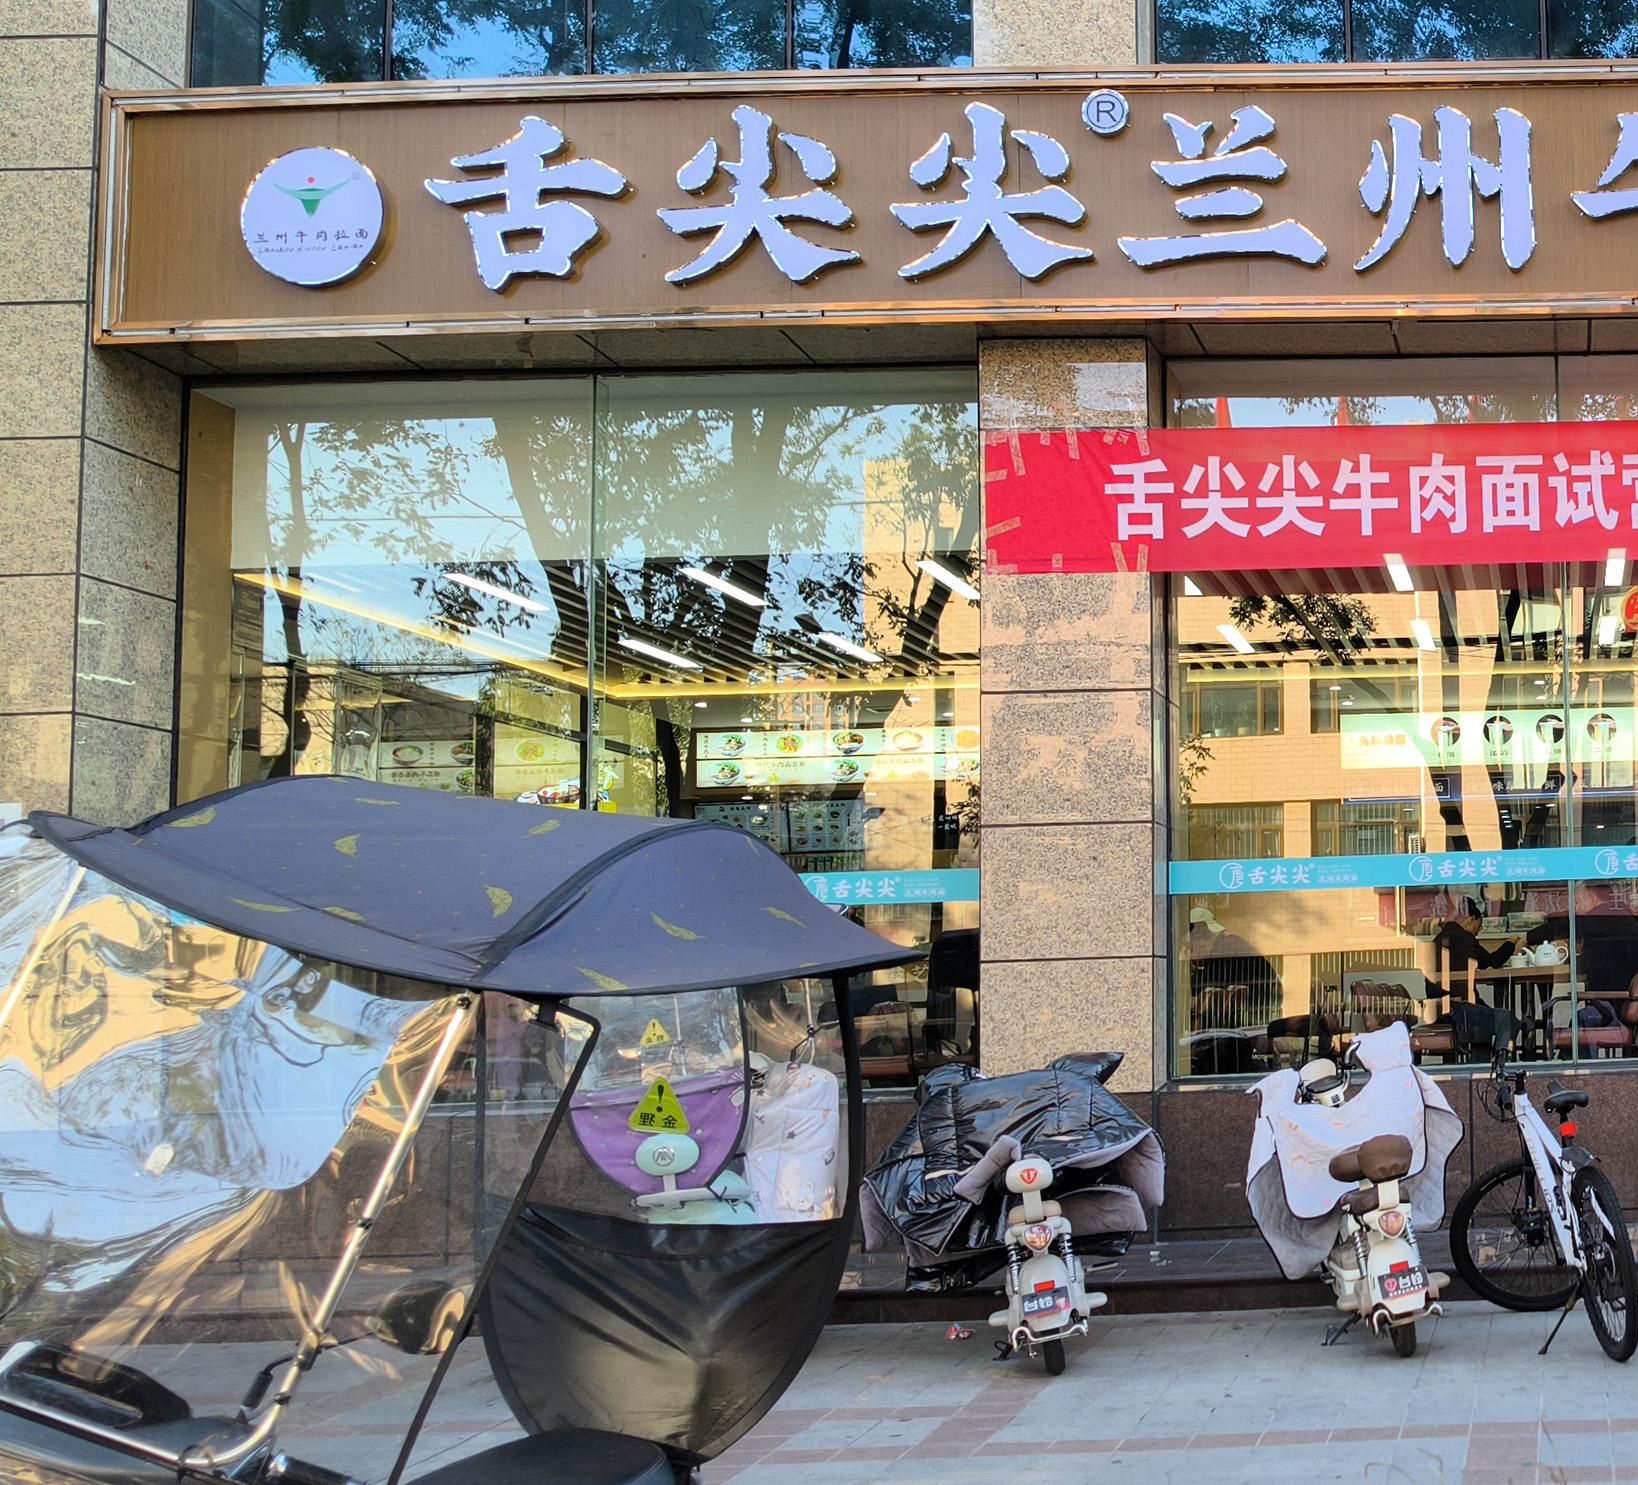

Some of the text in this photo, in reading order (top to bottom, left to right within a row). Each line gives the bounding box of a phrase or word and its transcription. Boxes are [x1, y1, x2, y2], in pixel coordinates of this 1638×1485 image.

[253, 228, 368, 244] 兰州牛肉拉面
[1248, 864, 1311, 886] 舌尖尖
[1437, 856, 1499, 878] 舌尖尖
[832, 877, 897, 900] 舌尖尖
